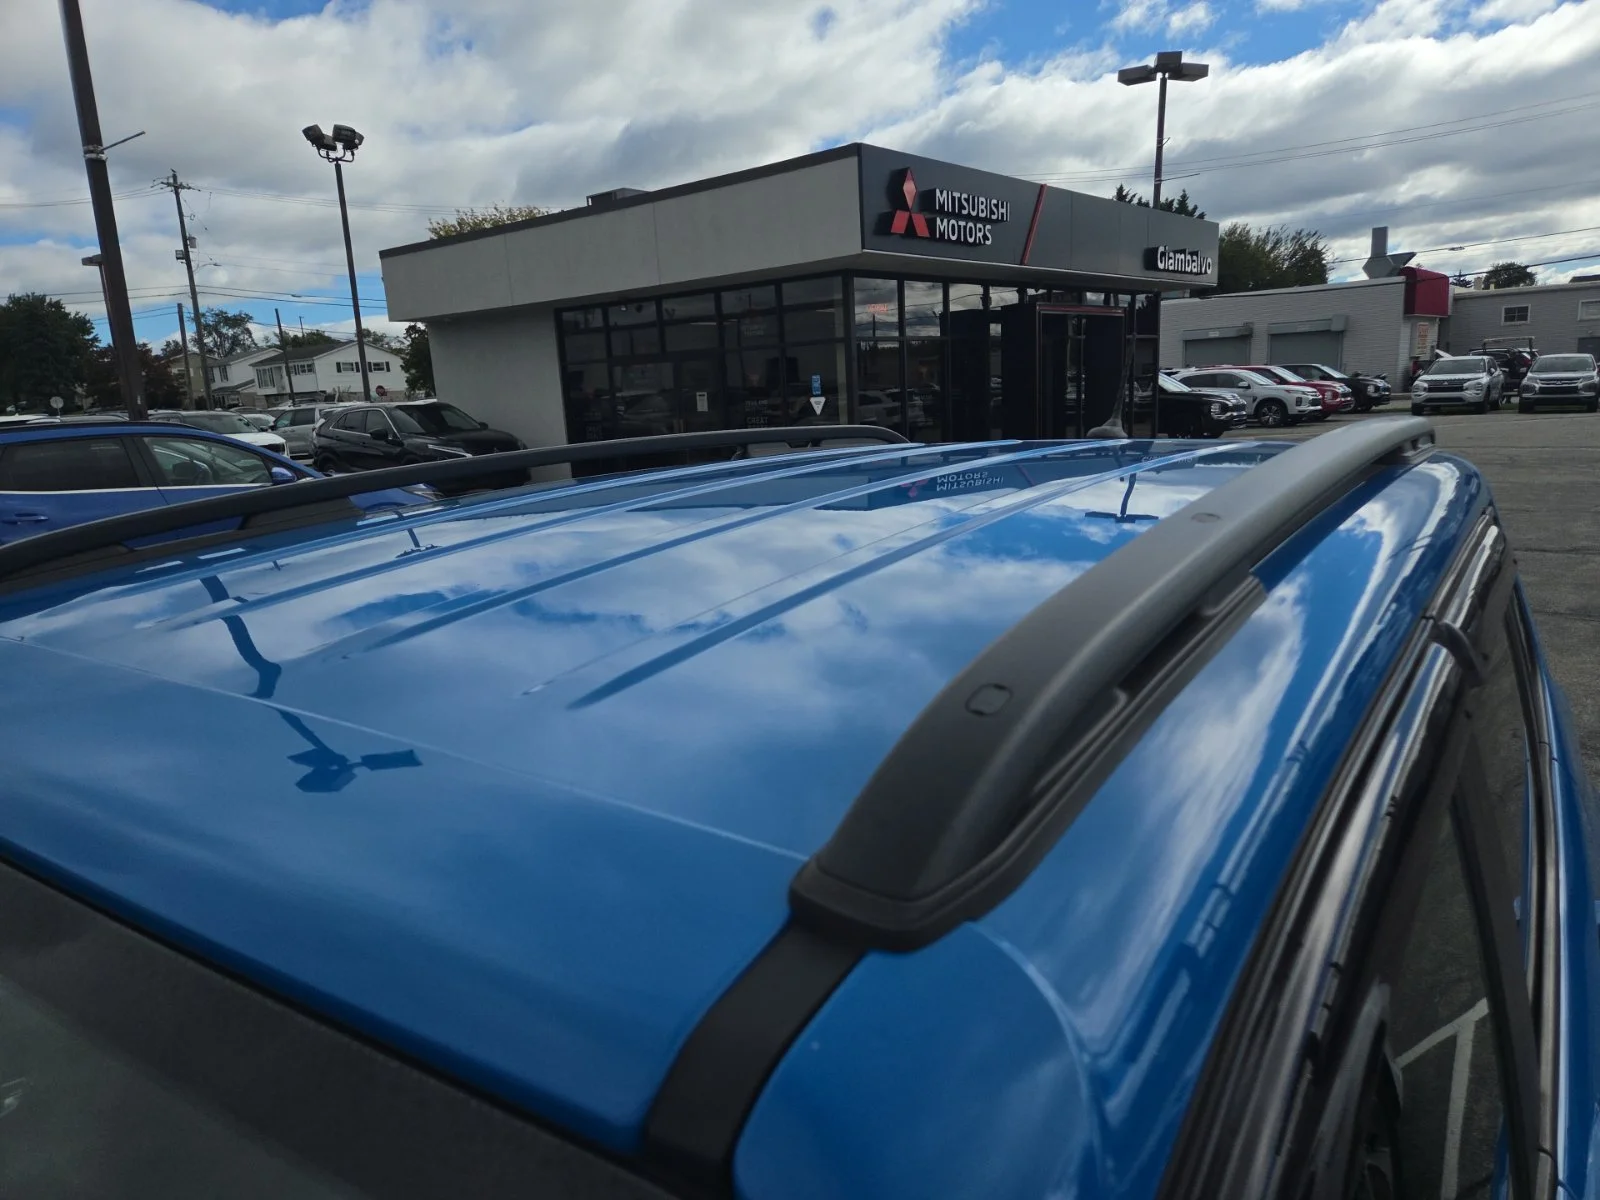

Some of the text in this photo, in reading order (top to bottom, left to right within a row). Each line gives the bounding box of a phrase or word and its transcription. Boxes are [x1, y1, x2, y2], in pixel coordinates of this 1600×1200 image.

[936, 188, 1010, 221] MITSUBISHI
[936, 217, 992, 245] MOTORS
[1157, 245, 1212, 274] Giambalvo
